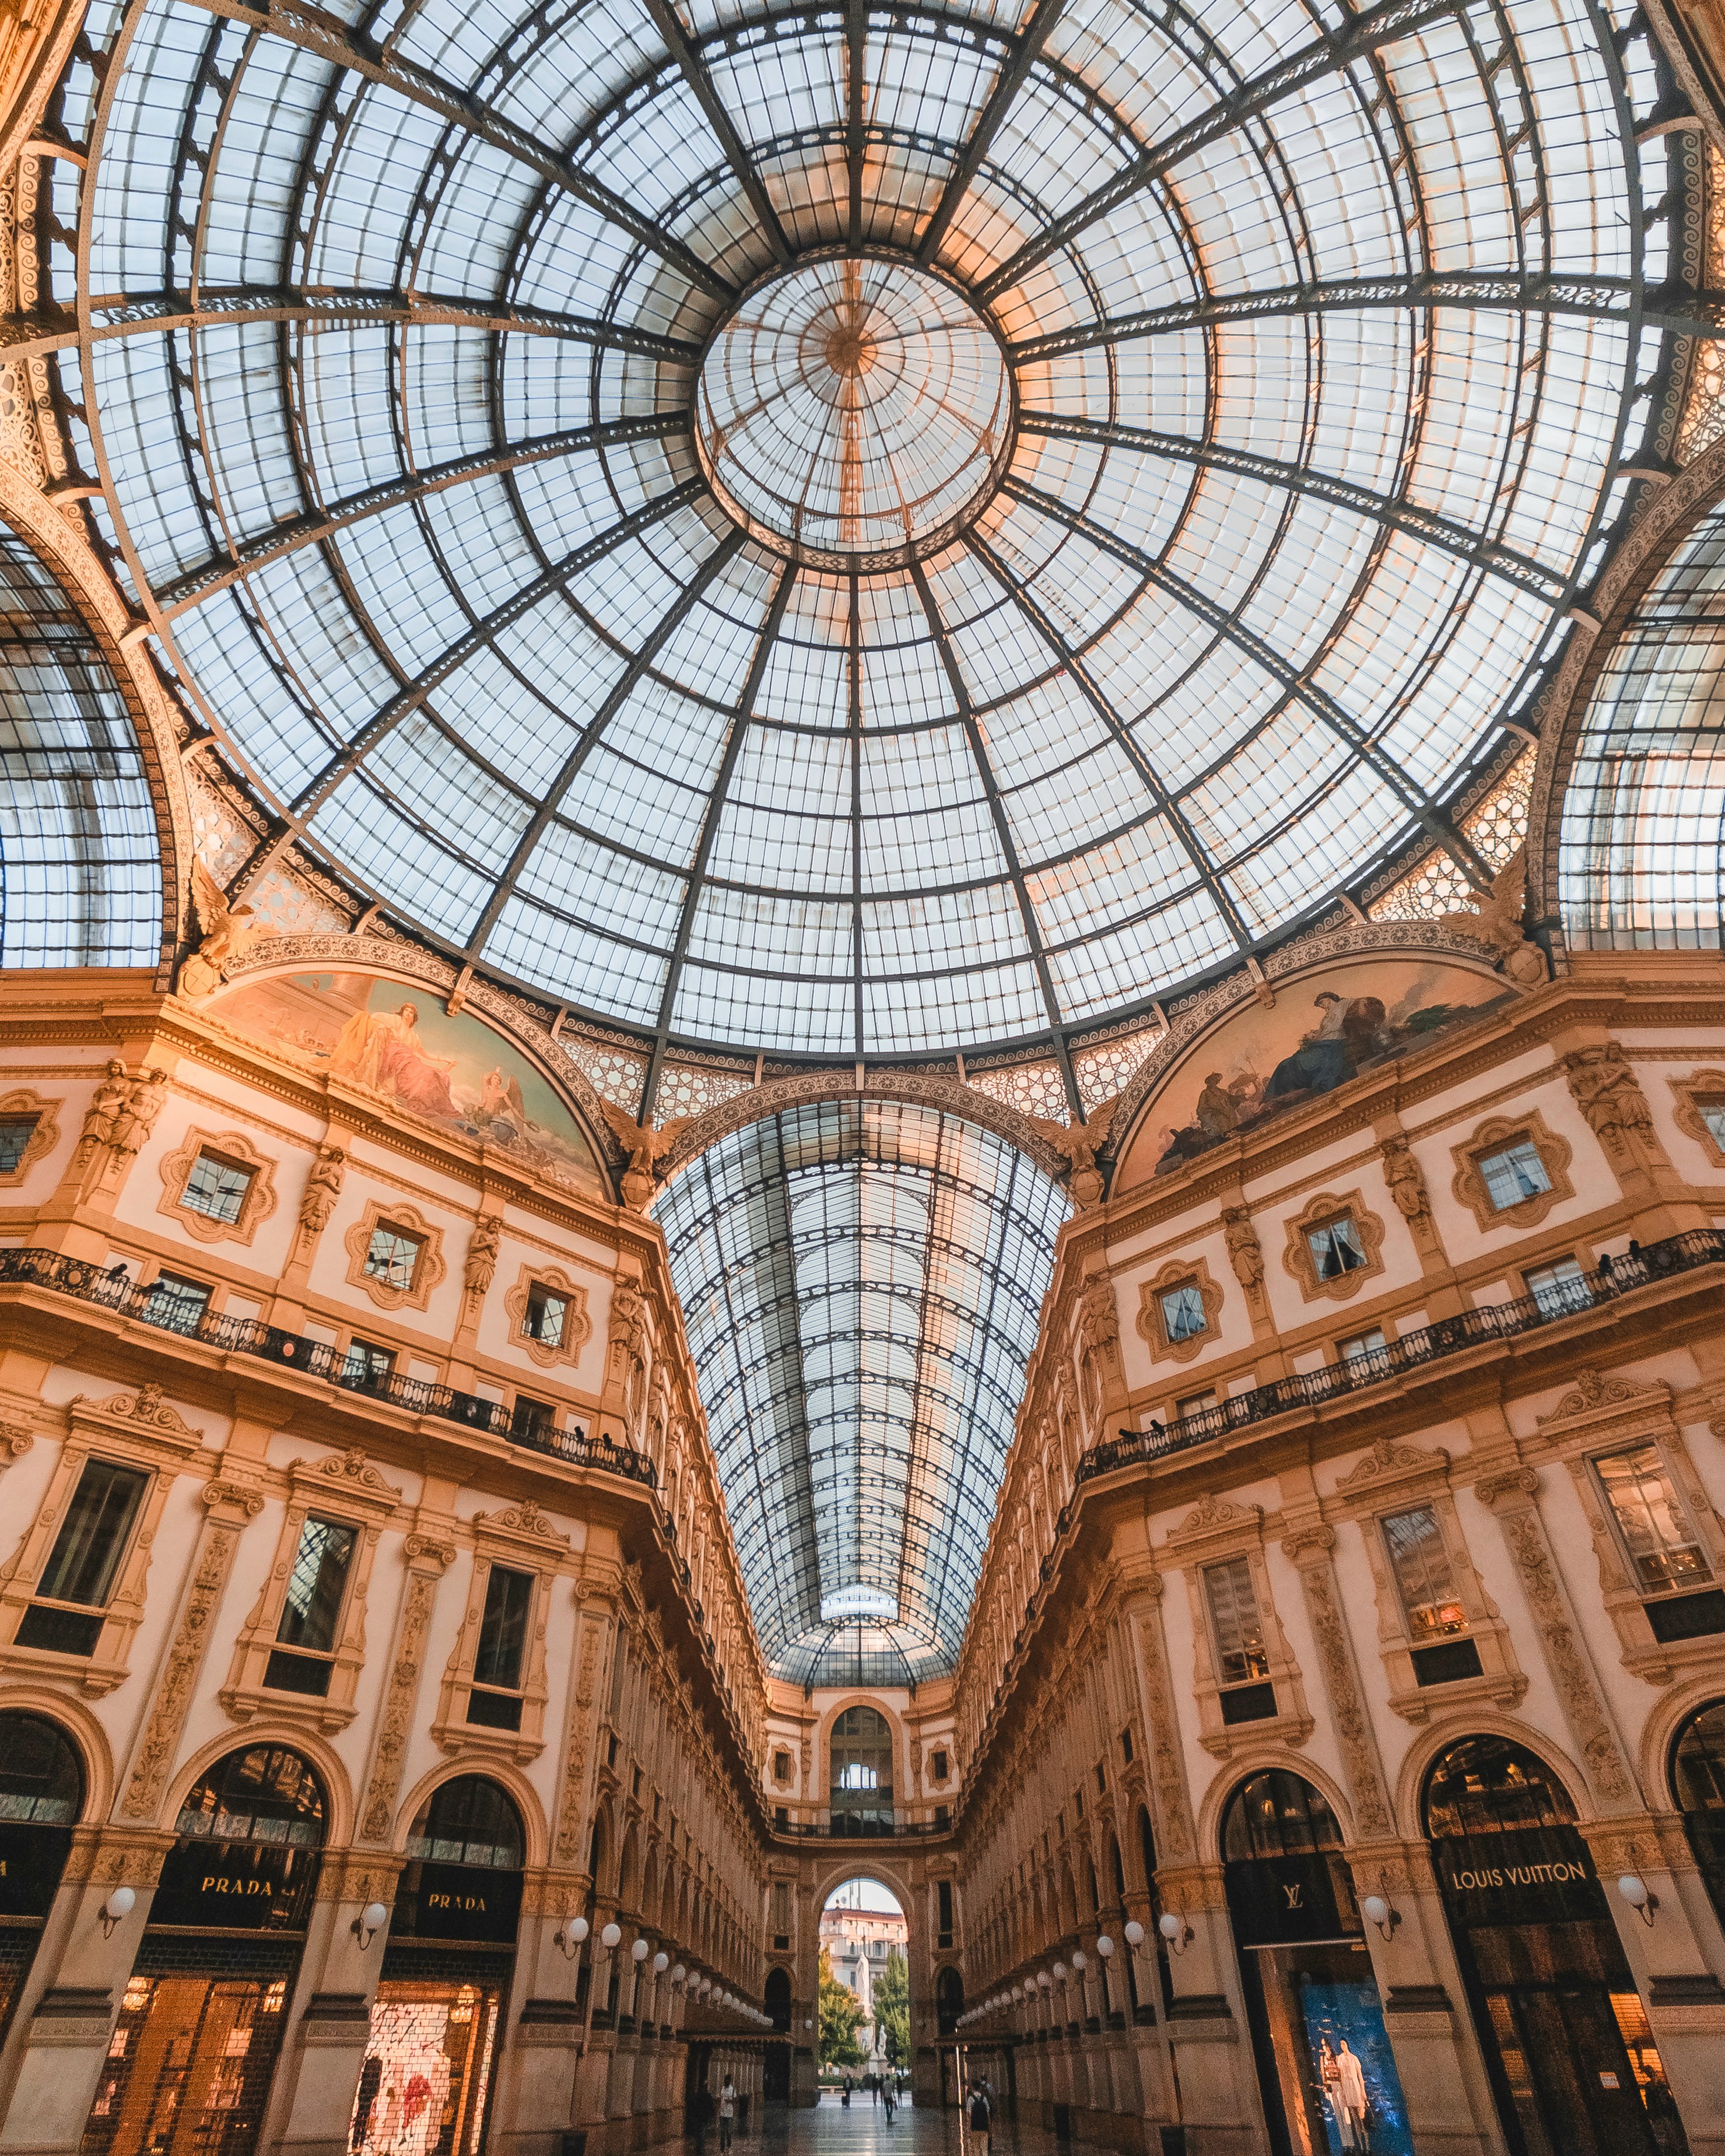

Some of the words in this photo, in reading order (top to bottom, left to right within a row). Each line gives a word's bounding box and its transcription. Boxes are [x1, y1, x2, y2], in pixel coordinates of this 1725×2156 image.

[1453, 1868, 1503, 1889] LOUIS
[1505, 1861, 1586, 1885] VUITTON
[202, 1877, 271, 1896] PRADA
[429, 1894, 485, 1911] PRADA
